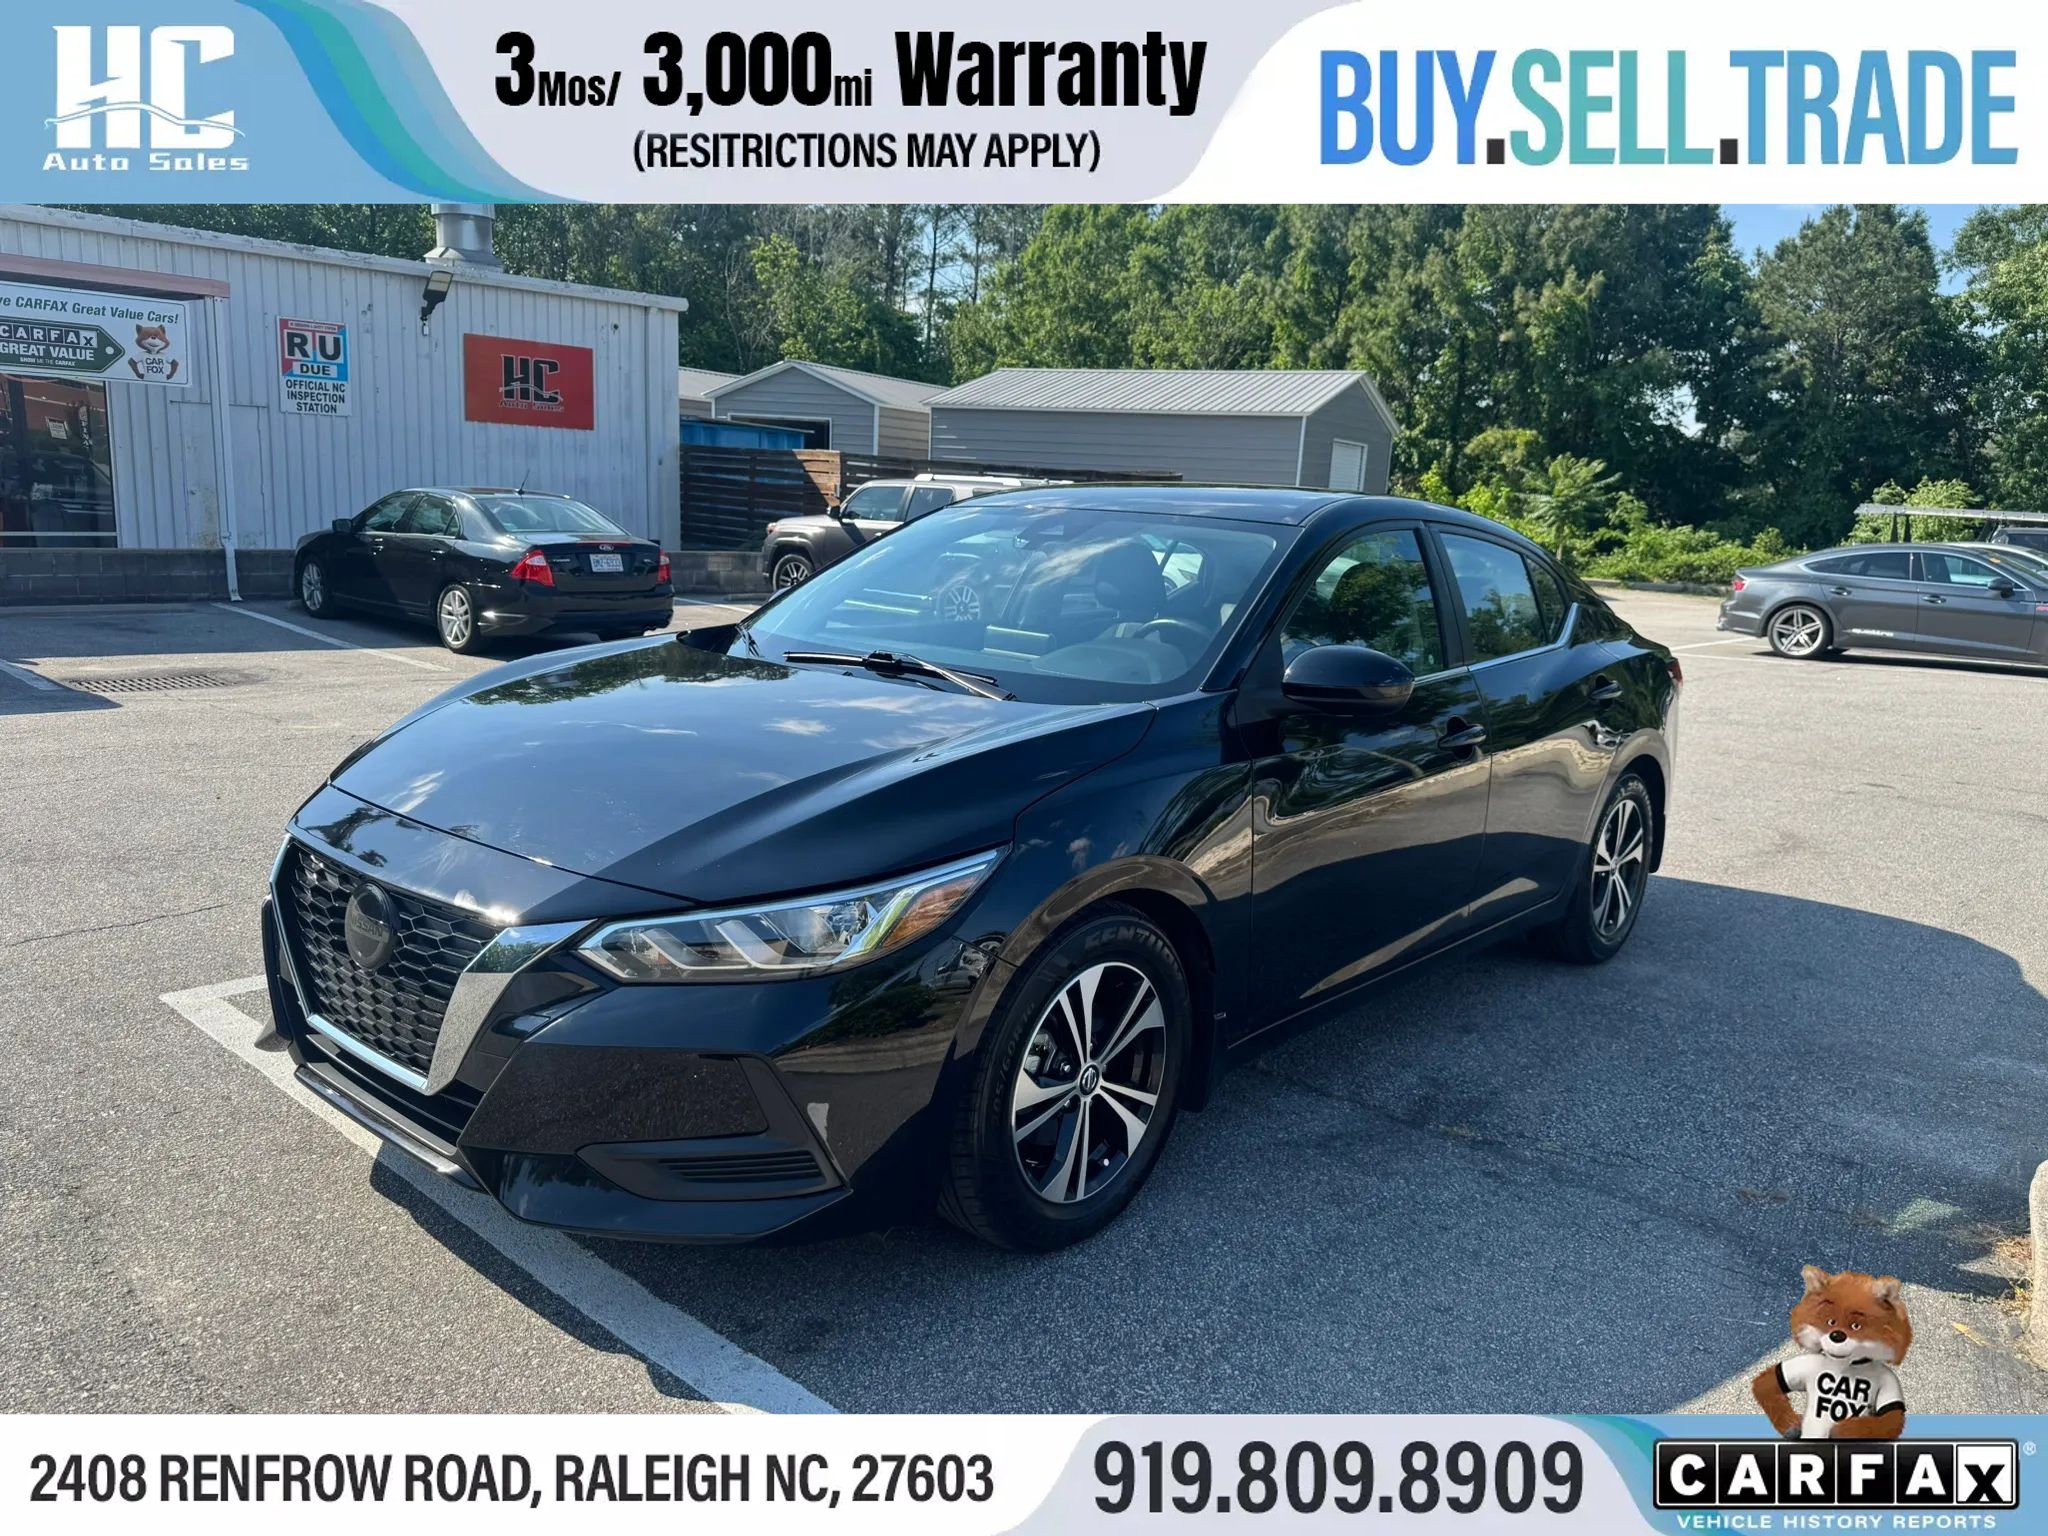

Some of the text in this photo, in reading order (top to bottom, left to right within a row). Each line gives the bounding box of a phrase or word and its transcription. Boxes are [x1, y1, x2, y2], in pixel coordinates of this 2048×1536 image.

[15, 296, 68, 313] CARFAX
[72, 302, 106, 317] Great
[110, 306, 144, 321] Value
[147, 310, 179, 324] Cars!
[0, 325, 95, 348] CARFAX
[0, 341, 95, 361] GREAT VALUE
[145, 356, 165, 366] CAR
[146, 365, 165, 375] FOX
[299, 363, 332, 376] DUE
[285, 378, 346, 393] OFFICIAL NC
[501, 354, 560, 404] HC
[286, 389, 345, 404] INSPECTION
[296, 401, 337, 414] STATION
[350, 912, 383, 937] NISSAN
